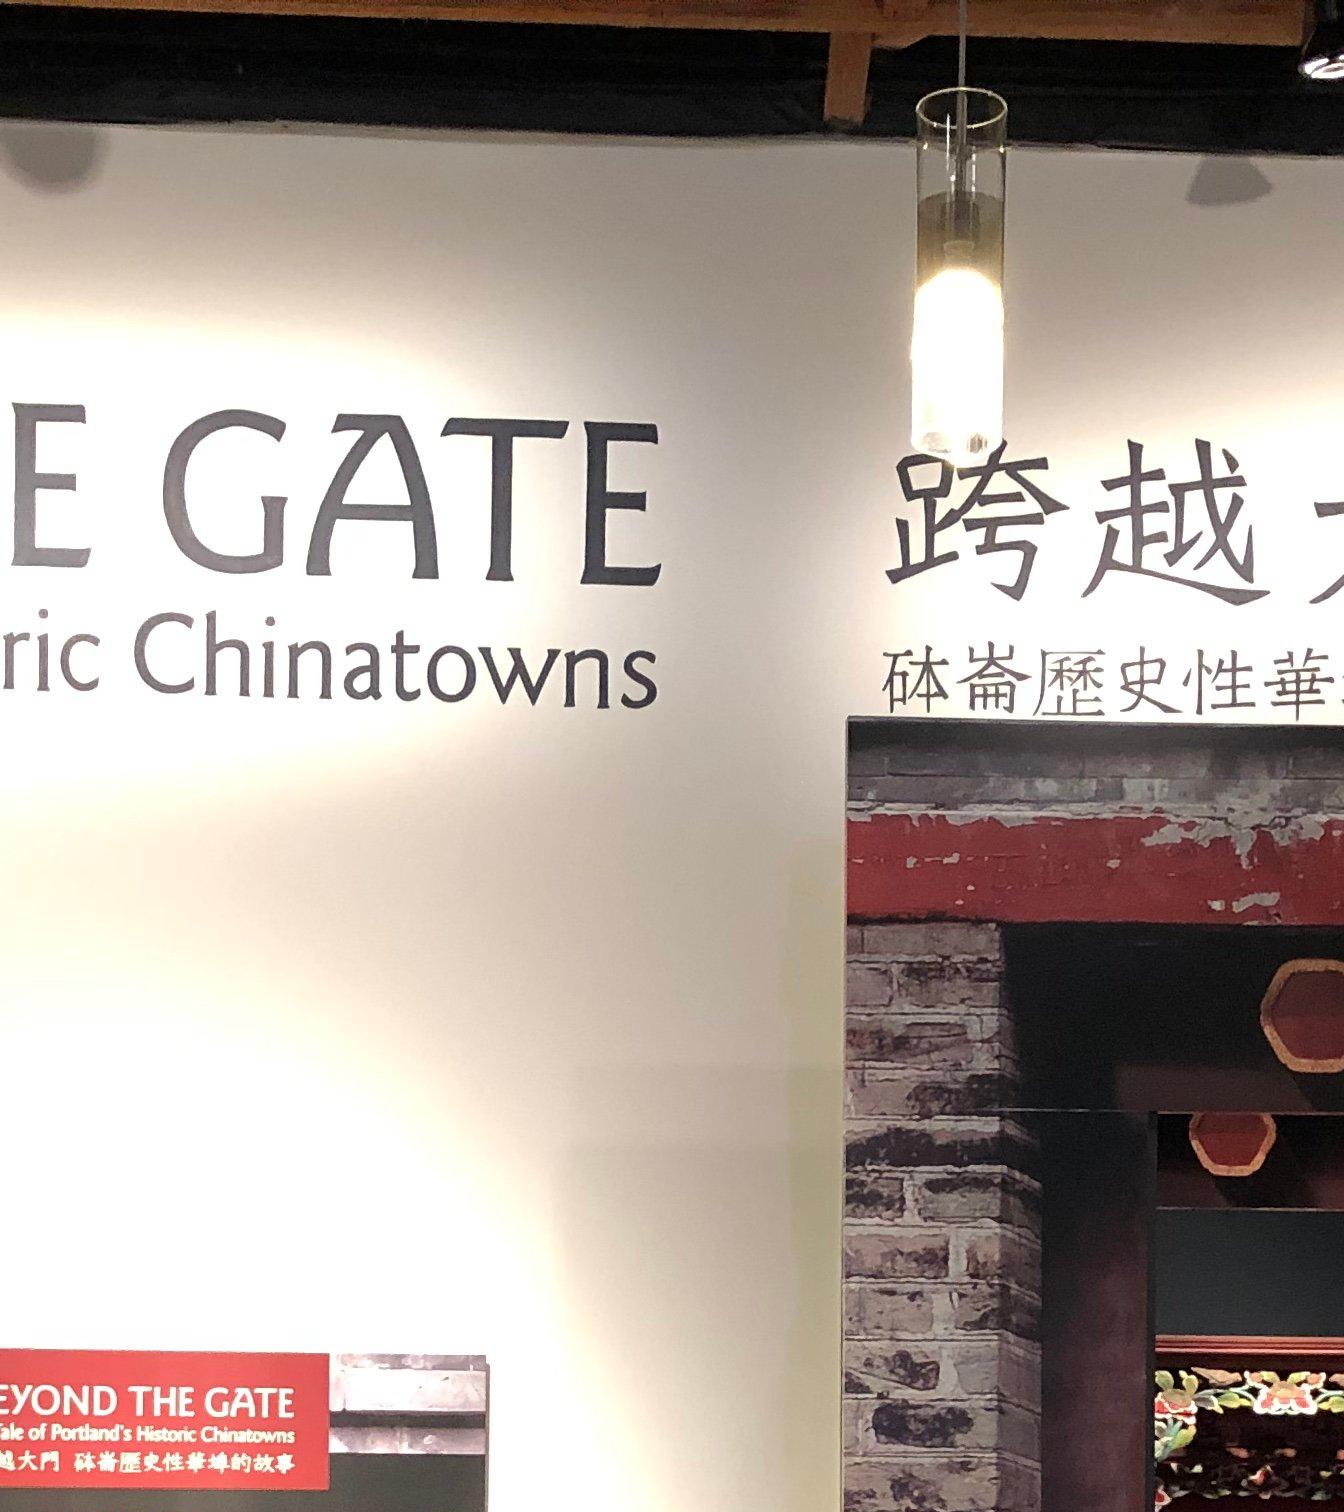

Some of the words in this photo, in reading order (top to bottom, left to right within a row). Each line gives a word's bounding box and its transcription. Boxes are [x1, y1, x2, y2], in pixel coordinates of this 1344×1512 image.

[163, 410, 661, 586] GATE
[134, 609, 661, 709] Chinatowns
[28, 1423, 47, 1440] of
[51, 1424, 132, 1441] Portland's
[137, 1426, 196, 1442] Historic
[201, 1426, 294, 1443] Chinatowns
[128, 1386, 194, 1417] THE
[205, 1387, 294, 1418] GATE
